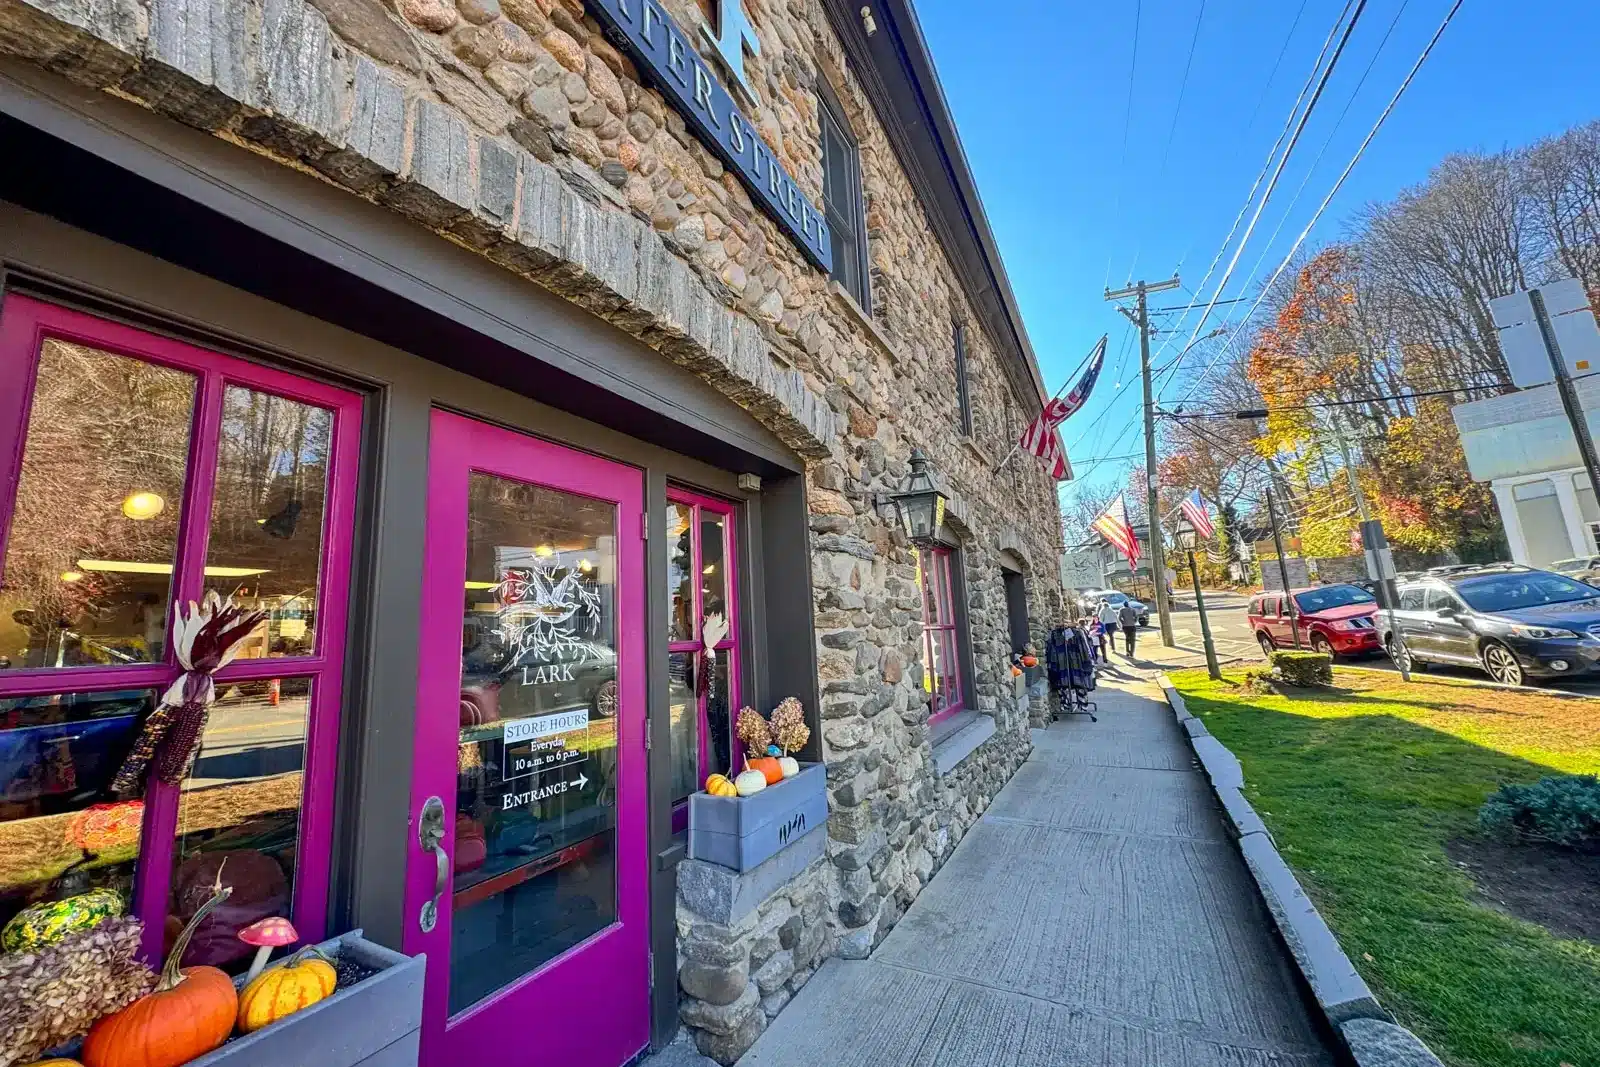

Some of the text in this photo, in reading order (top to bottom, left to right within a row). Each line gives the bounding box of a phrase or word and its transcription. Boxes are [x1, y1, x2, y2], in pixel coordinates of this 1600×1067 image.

[729, 111, 825, 256] STREET
[521, 663, 575, 686] LARK
[506, 713, 587, 738] STORE HOURS
[530, 737, 566, 752] Everyday
[515, 749, 579, 771] 10 a.m. to 6 p.m.
[502, 781, 568, 811] ENTRANCE
